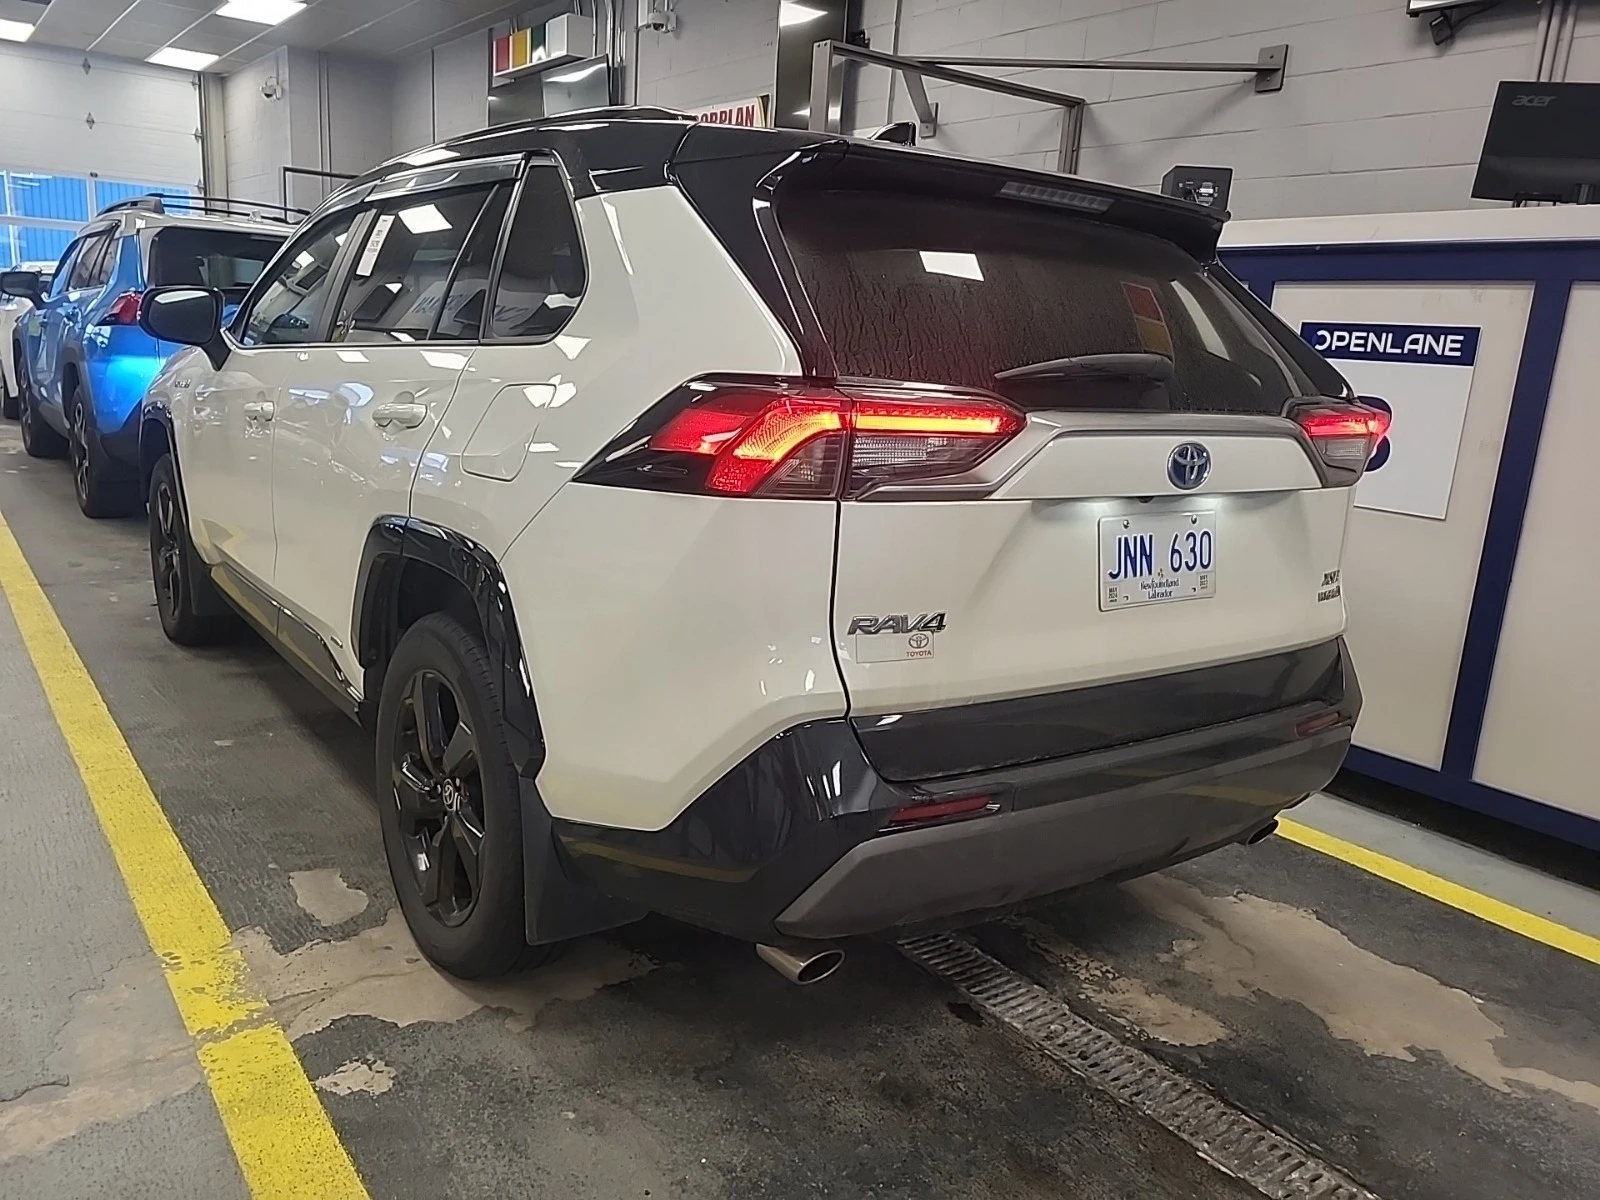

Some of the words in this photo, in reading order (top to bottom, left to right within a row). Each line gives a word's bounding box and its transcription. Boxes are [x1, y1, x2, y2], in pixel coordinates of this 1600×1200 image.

[1512, 95, 1557, 107] acer
[1314, 330, 1464, 356] OPENLANE
[1108, 534, 1154, 579] JNN
[1170, 530, 1212, 573] 630
[847, 612, 947, 636] RAV4
